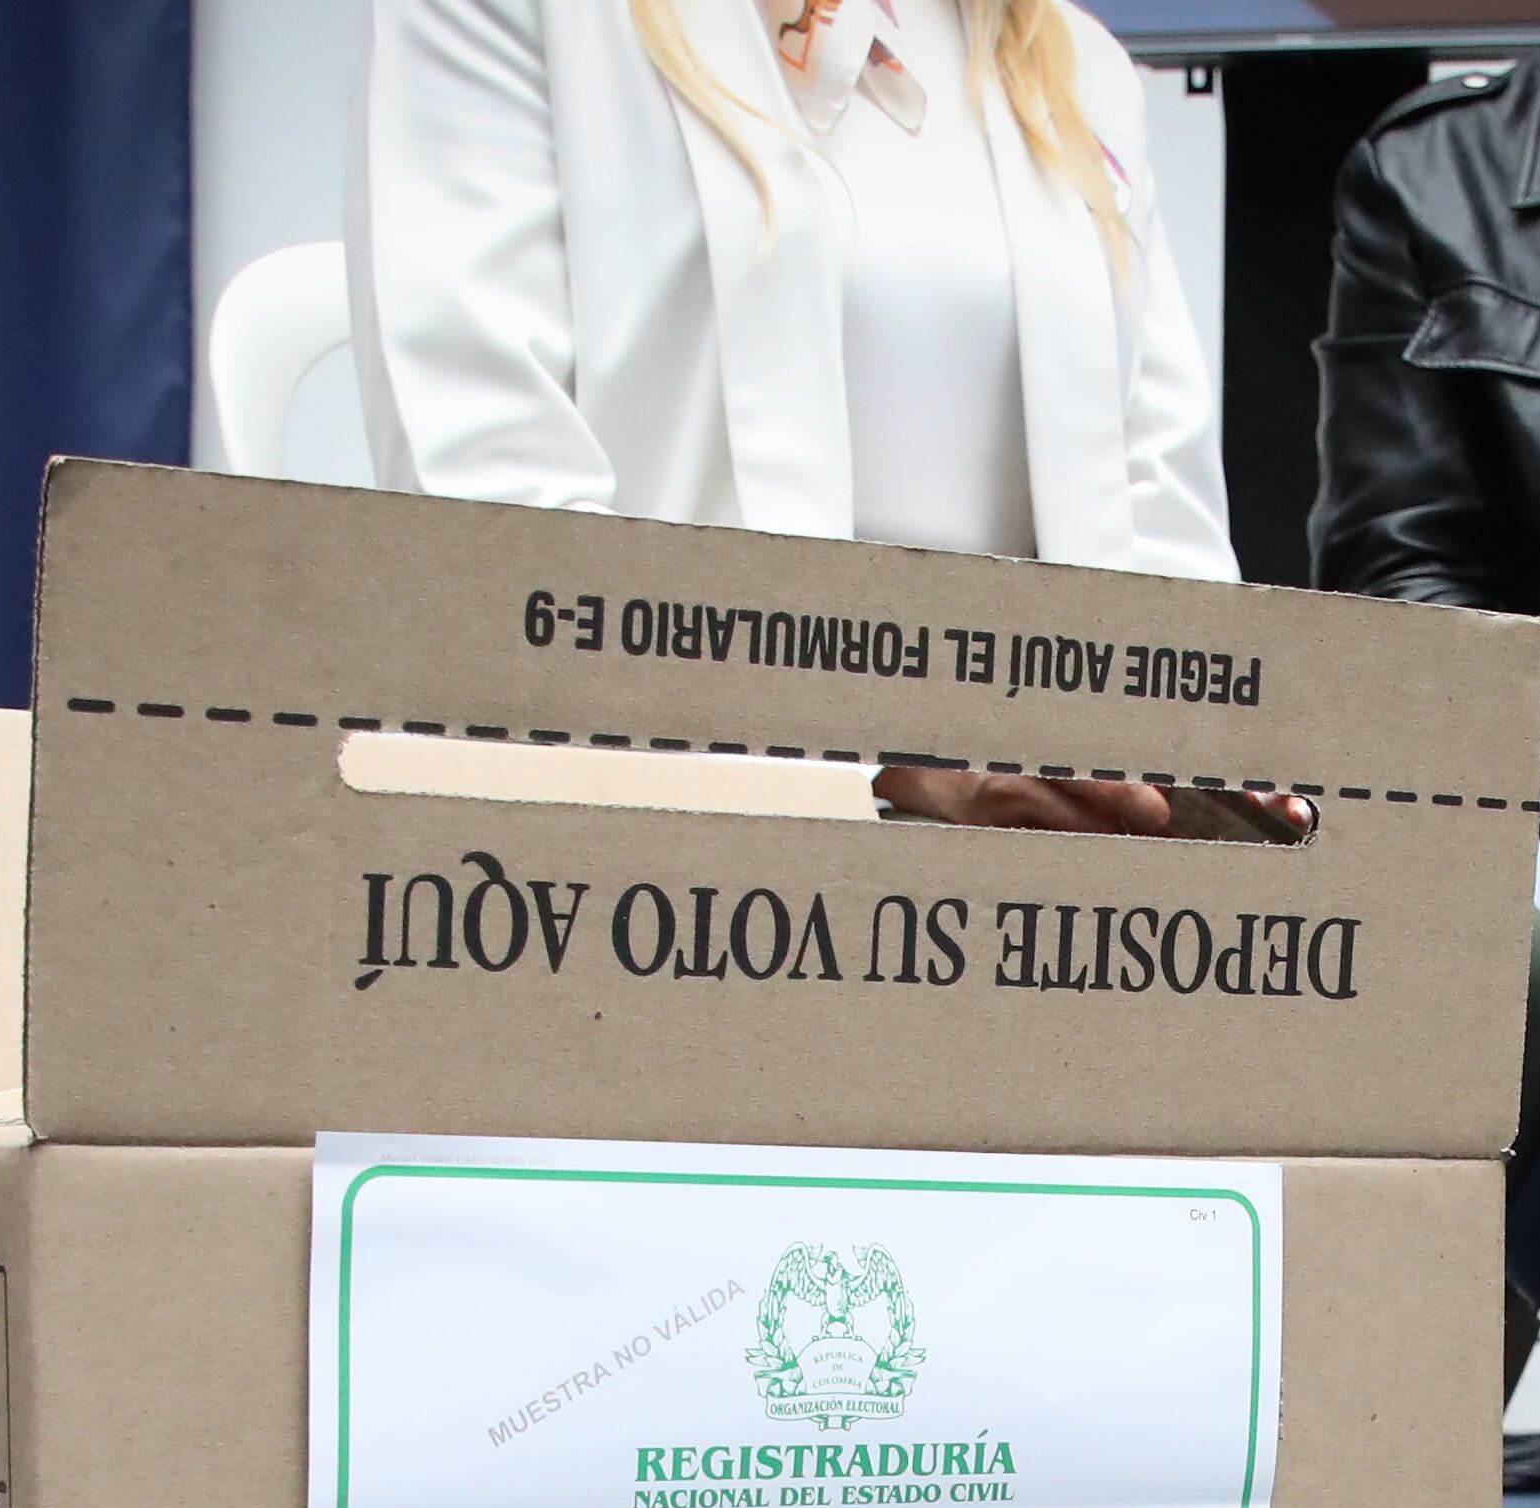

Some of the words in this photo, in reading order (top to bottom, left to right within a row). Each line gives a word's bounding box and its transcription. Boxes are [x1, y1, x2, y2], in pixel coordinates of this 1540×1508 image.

[524, 590, 605, 651] E-9
[621, 599, 929, 678] FORMULARIO
[944, 629, 996, 684] EL
[1006, 634, 1114, 698] AQUÍ
[1124, 645, 1261, 706] PEGUE
[353, 850, 591, 991] AQUÍ
[610, 881, 844, 983] VOTO
[863, 894, 969, 988] SU
[995, 902, 1361, 1000] DEPOSITE
[487, 1361, 612, 1448] MUESTRA
[613, 1334, 651, 1370] NO
[654, 1278, 746, 1342] VÁLIDA
[812, 1375, 862, 1390] COLOMBIA
[770, 1395, 843, 1416] ORGANIZACIÓN
[846, 1398, 901, 1415] ELECTORAL
[634, 1428, 1018, 1483] REGISTRADURÍA
[780, 1486, 831, 1508] DEL
[841, 1483, 941, 1505] ESTADO
[949, 1481, 1015, 1502] CIVIL
